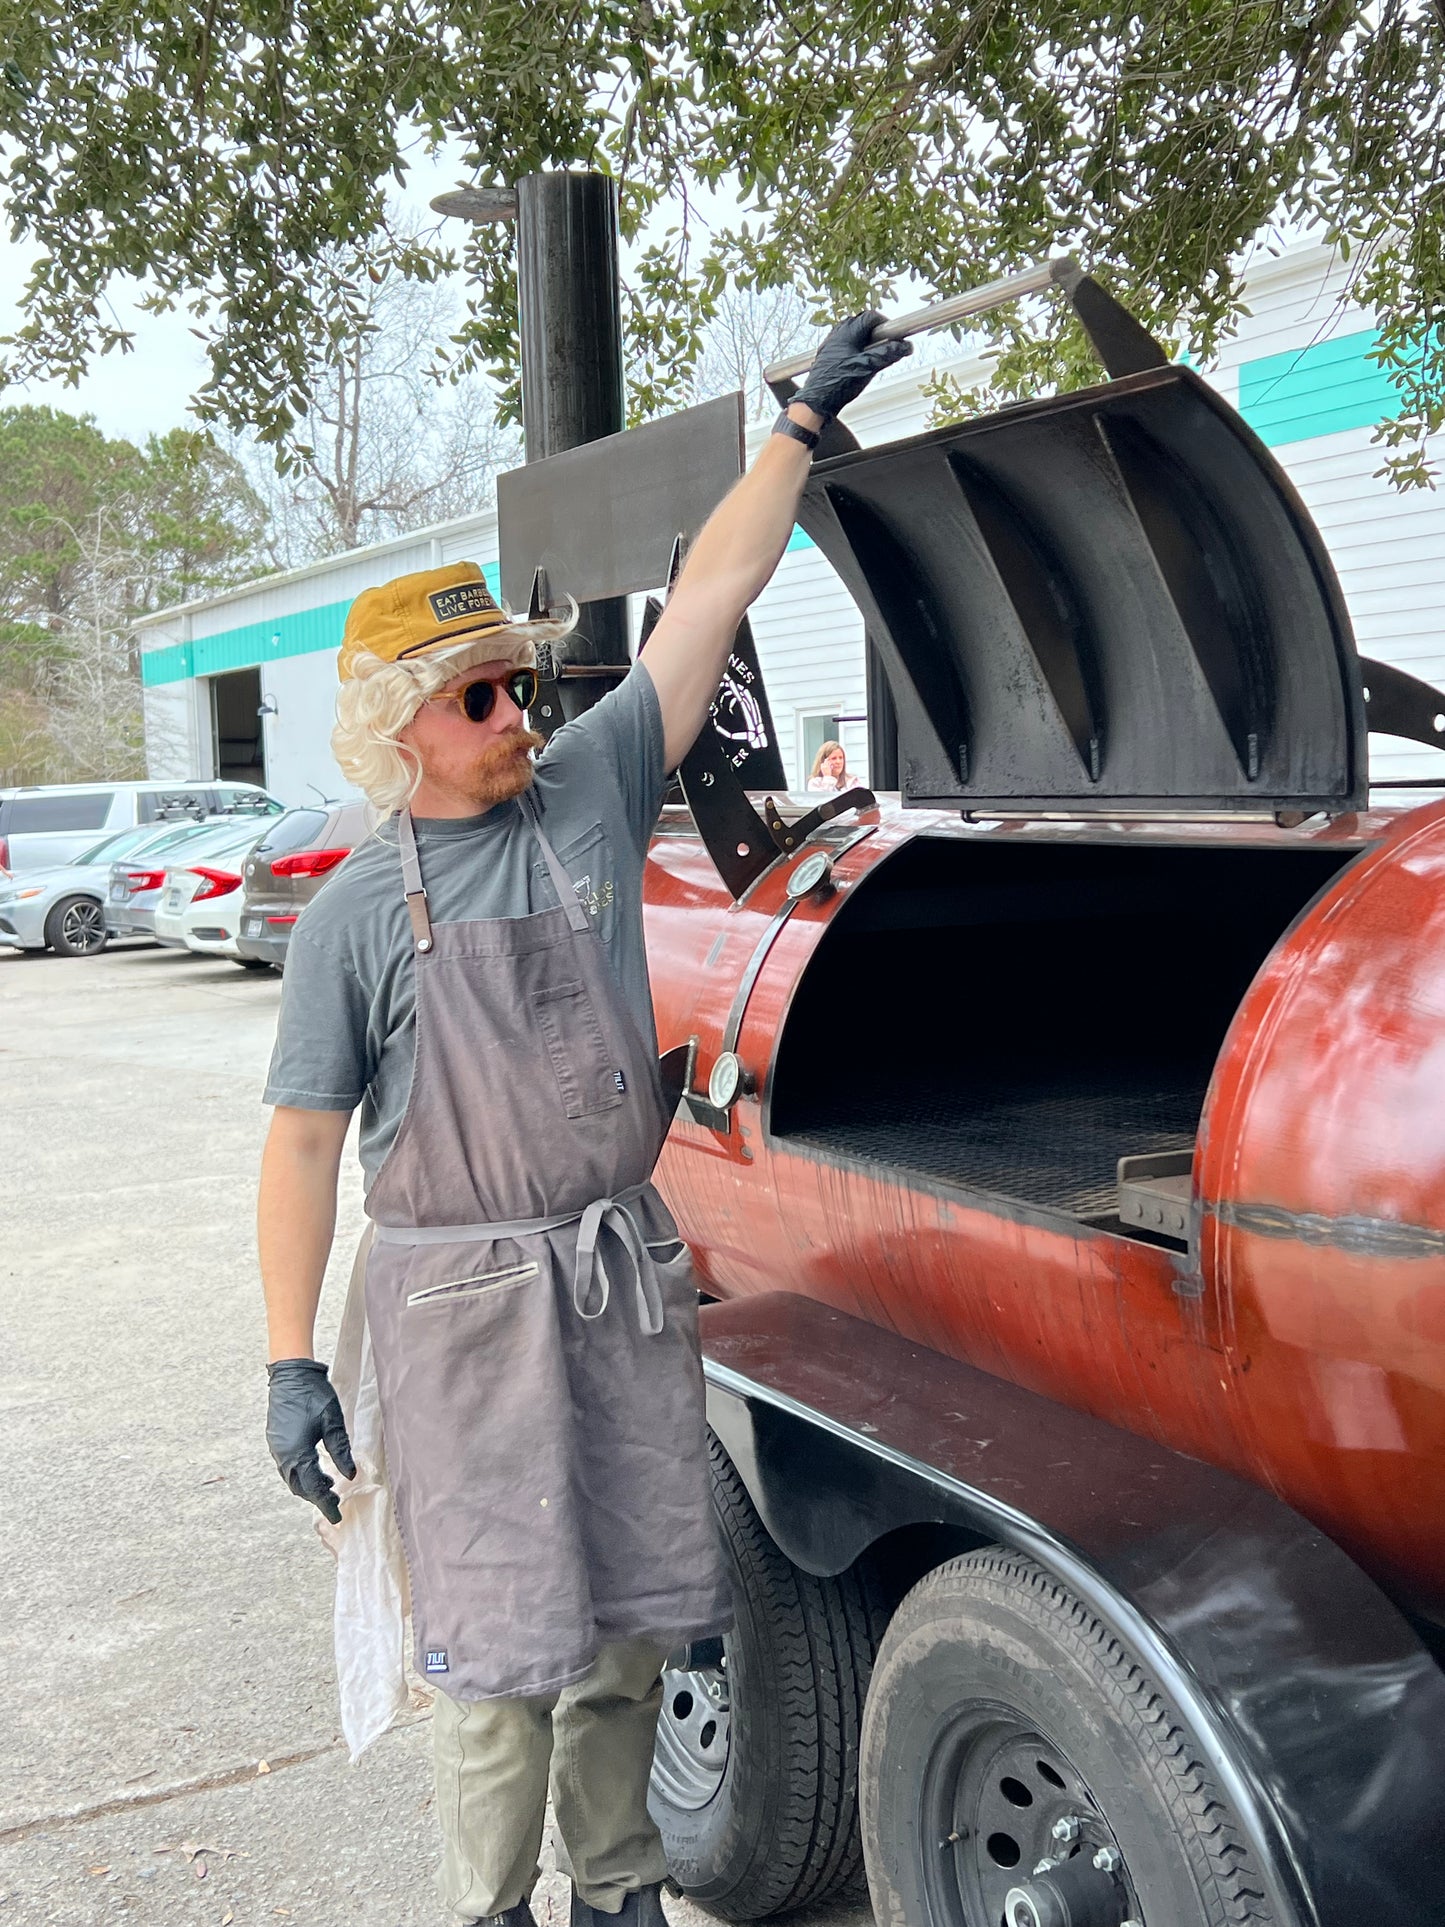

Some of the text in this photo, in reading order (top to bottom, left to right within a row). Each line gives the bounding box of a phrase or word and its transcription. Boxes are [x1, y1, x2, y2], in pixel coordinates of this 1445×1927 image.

[436, 594, 457, 608] EAT
[440, 597, 494, 617] LIVE FORE
